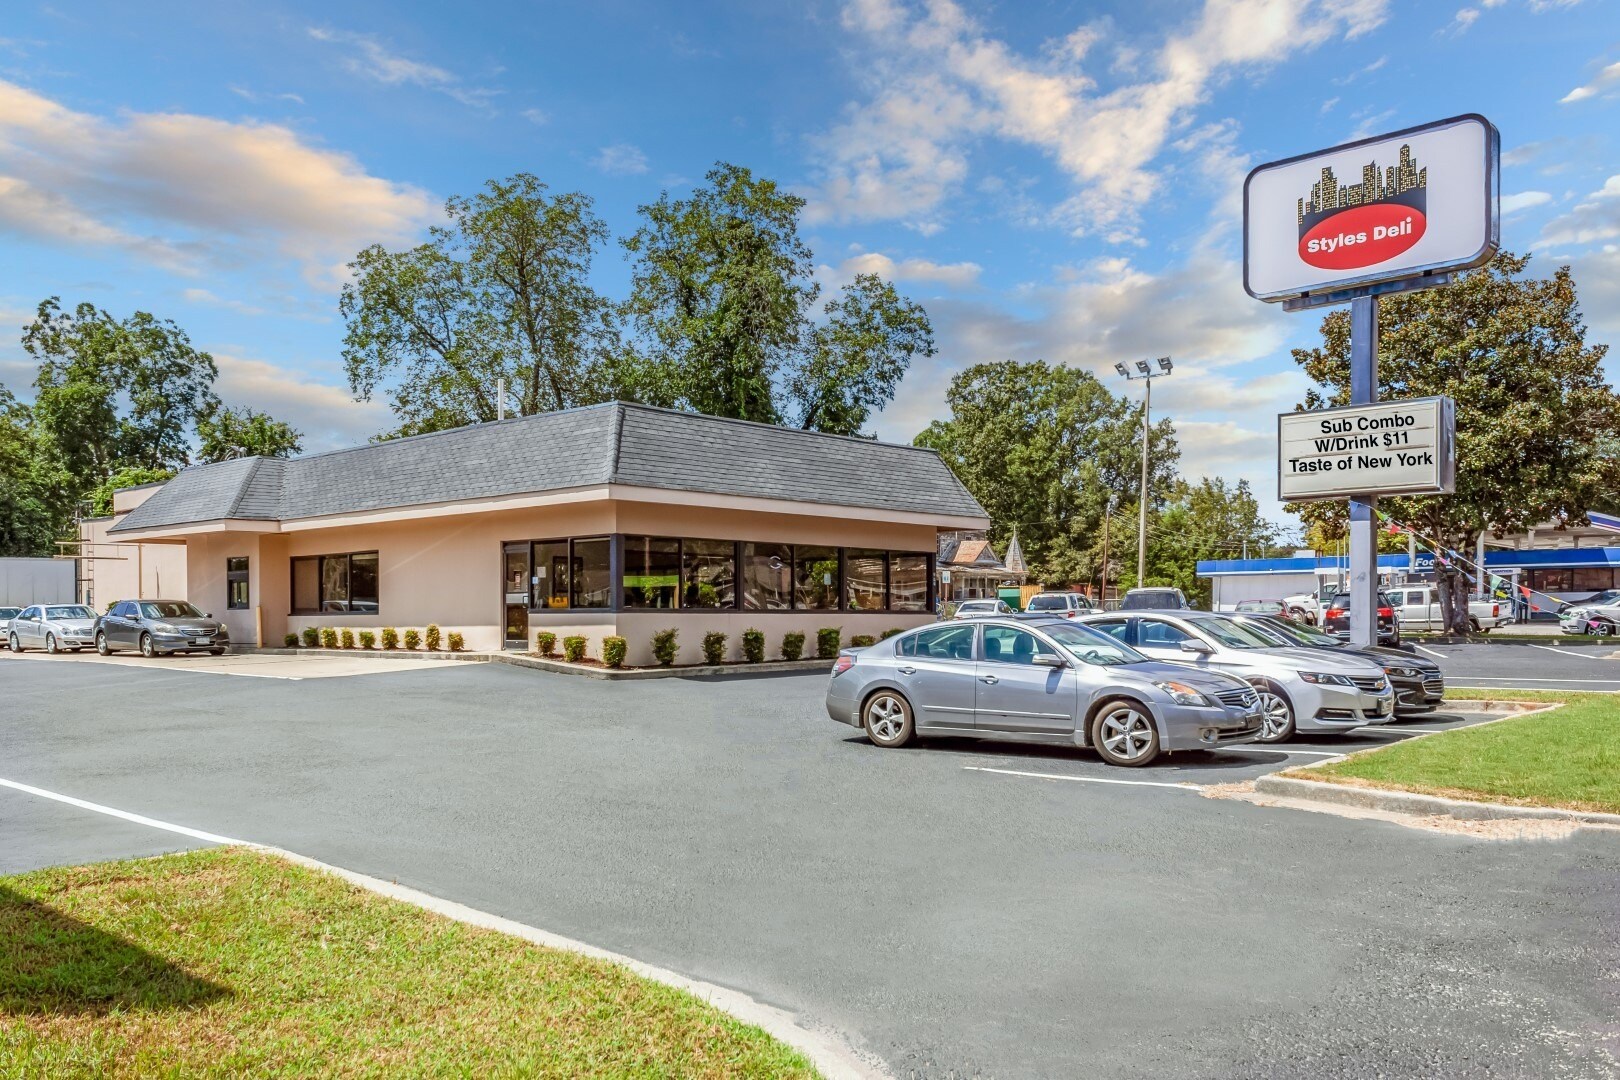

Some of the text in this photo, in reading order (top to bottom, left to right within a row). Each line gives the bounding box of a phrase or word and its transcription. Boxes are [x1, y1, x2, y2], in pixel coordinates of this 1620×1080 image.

[1307, 216, 1412, 253] Styles Deli
[1320, 414, 1415, 434] Sub Combo
[1314, 431, 1409, 453] W/Drink $11
[1288, 451, 1434, 473] Taste of New York
